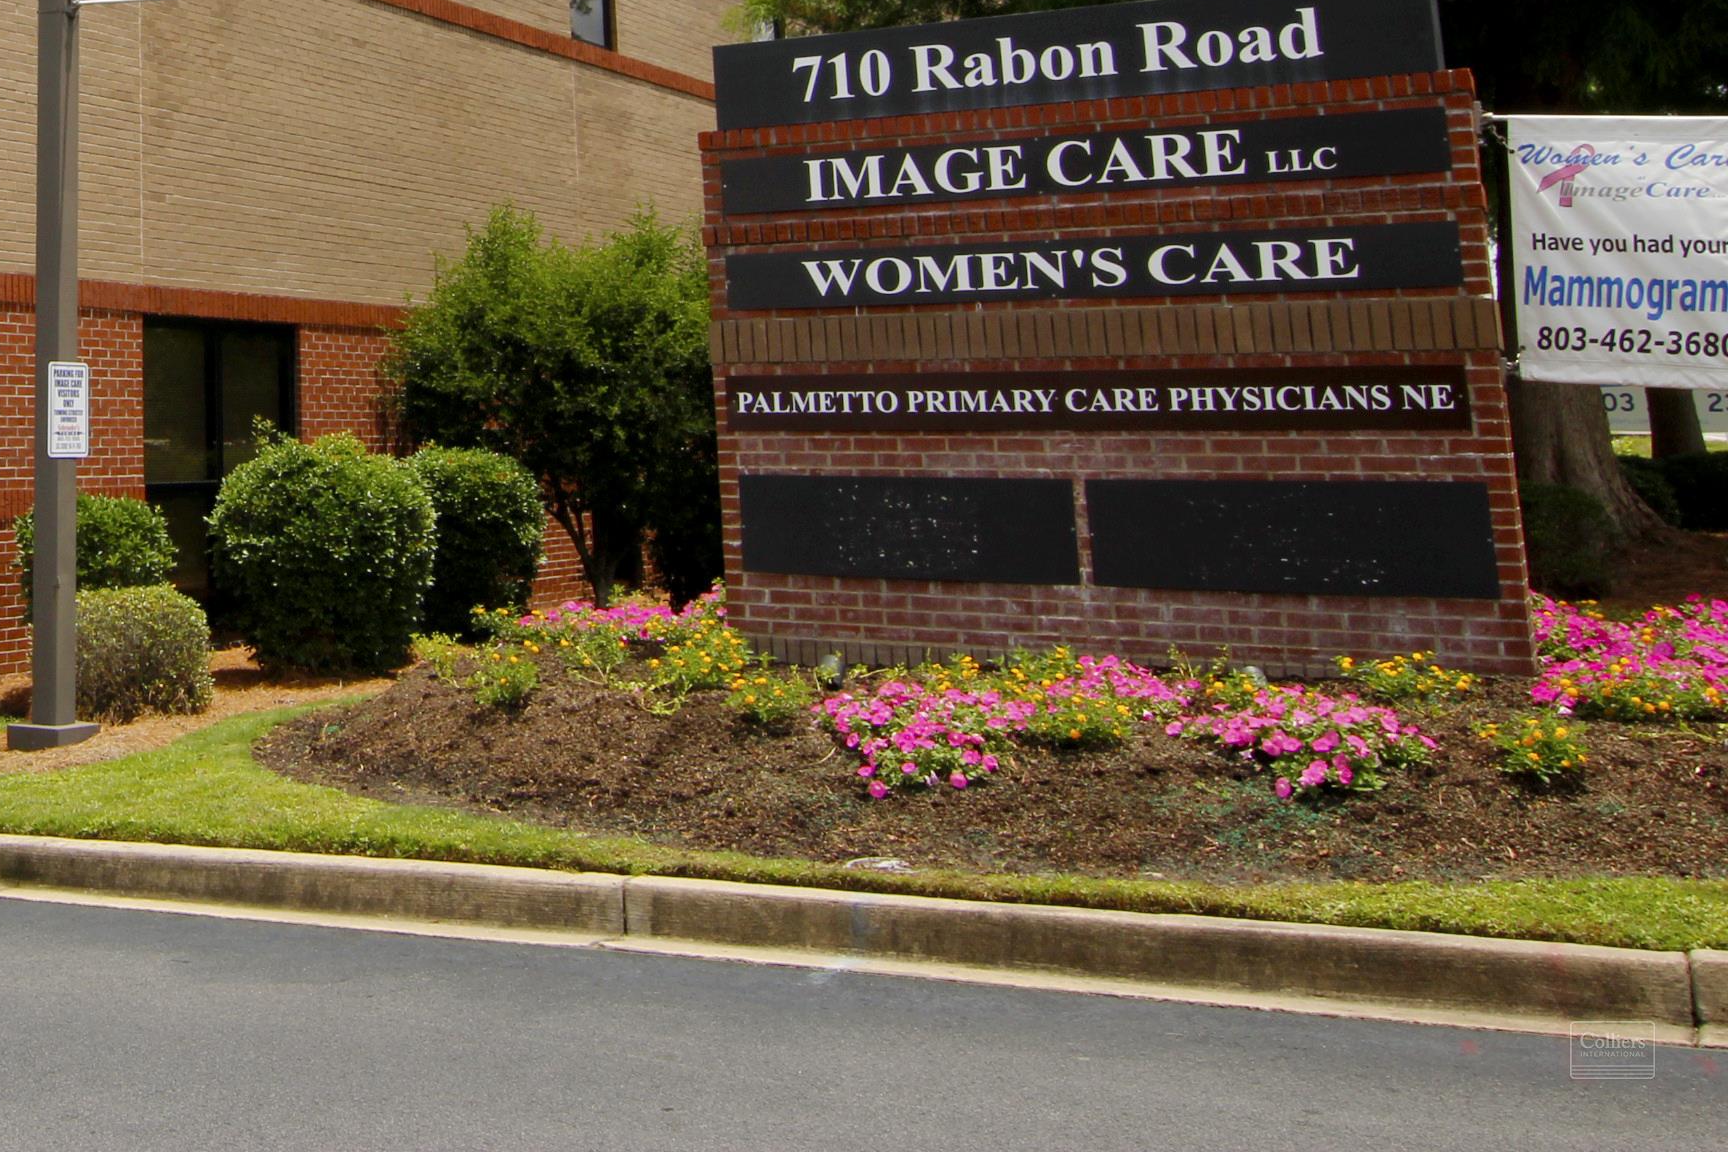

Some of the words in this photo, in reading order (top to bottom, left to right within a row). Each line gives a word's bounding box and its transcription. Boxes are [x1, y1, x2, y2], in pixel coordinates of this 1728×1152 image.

[793, 50, 890, 101] 710
[909, 38, 1117, 91] Rabon
[1136, 8, 1323, 72] Road
[804, 146, 1025, 201] IMAGE
[1048, 130, 1245, 185] CARE
[1266, 147, 1337, 173] LLC
[1517, 144, 1649, 166] Women's
[1665, 143, 1728, 169] Car
[802, 248, 1126, 296] WOMEN'S
[1148, 239, 1358, 284] CARE
[1532, 233, 1583, 250] Have
[1589, 237, 1626, 255] you
[1634, 235, 1673, 253] had
[1524, 266, 1728, 320] Mammogram
[738, 390, 898, 413] PALMETTO
[908, 390, 1056, 412] PRIMARY
[1066, 389, 1159, 411] CARE
[1170, 385, 1391, 410] PHYSICIANS
[1401, 384, 1454, 409] NE
